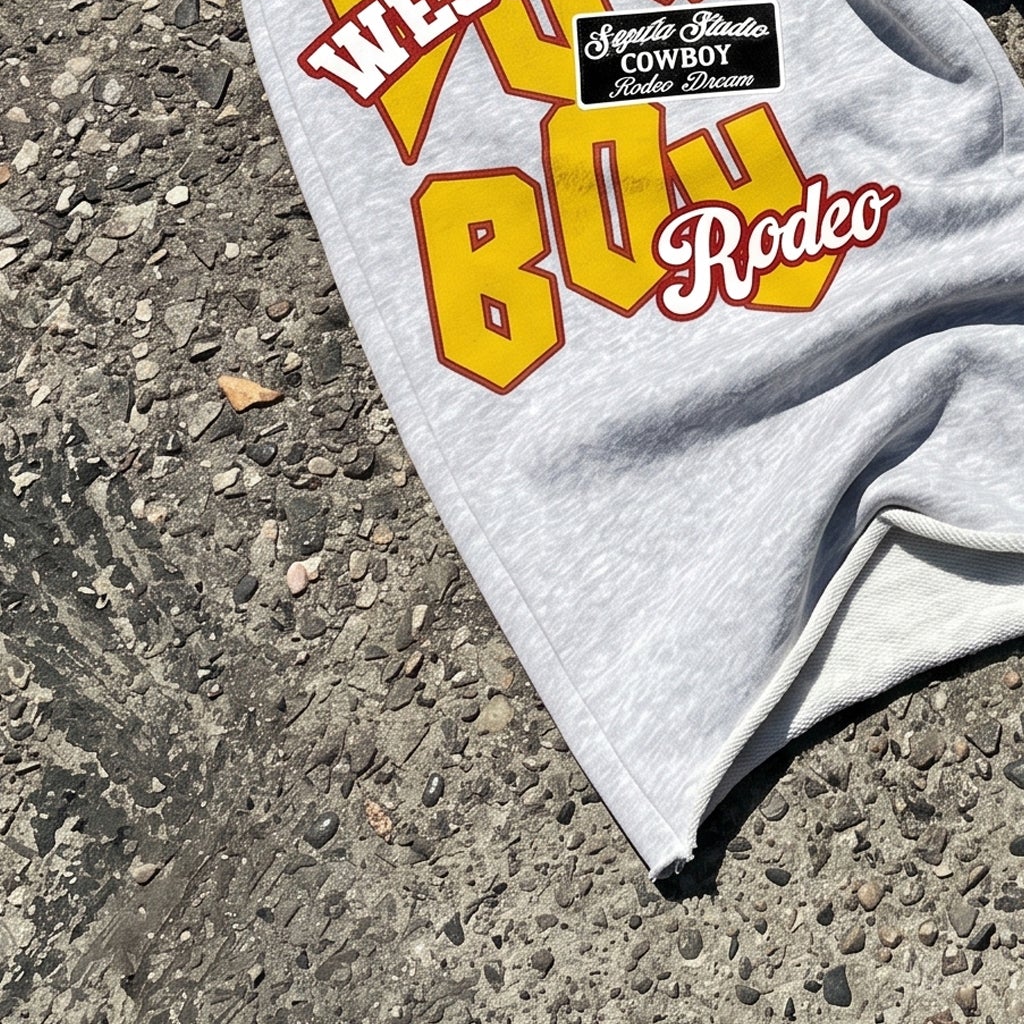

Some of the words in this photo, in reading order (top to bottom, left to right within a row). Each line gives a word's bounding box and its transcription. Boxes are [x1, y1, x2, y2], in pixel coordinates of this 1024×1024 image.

[679, 10, 769, 43] Studio
[621, 43, 731, 74] COWBOY
[609, 74, 675, 98] Rodeo
[681, 70, 754, 92] Dream
[656, 179, 897, 316] Rodeo
